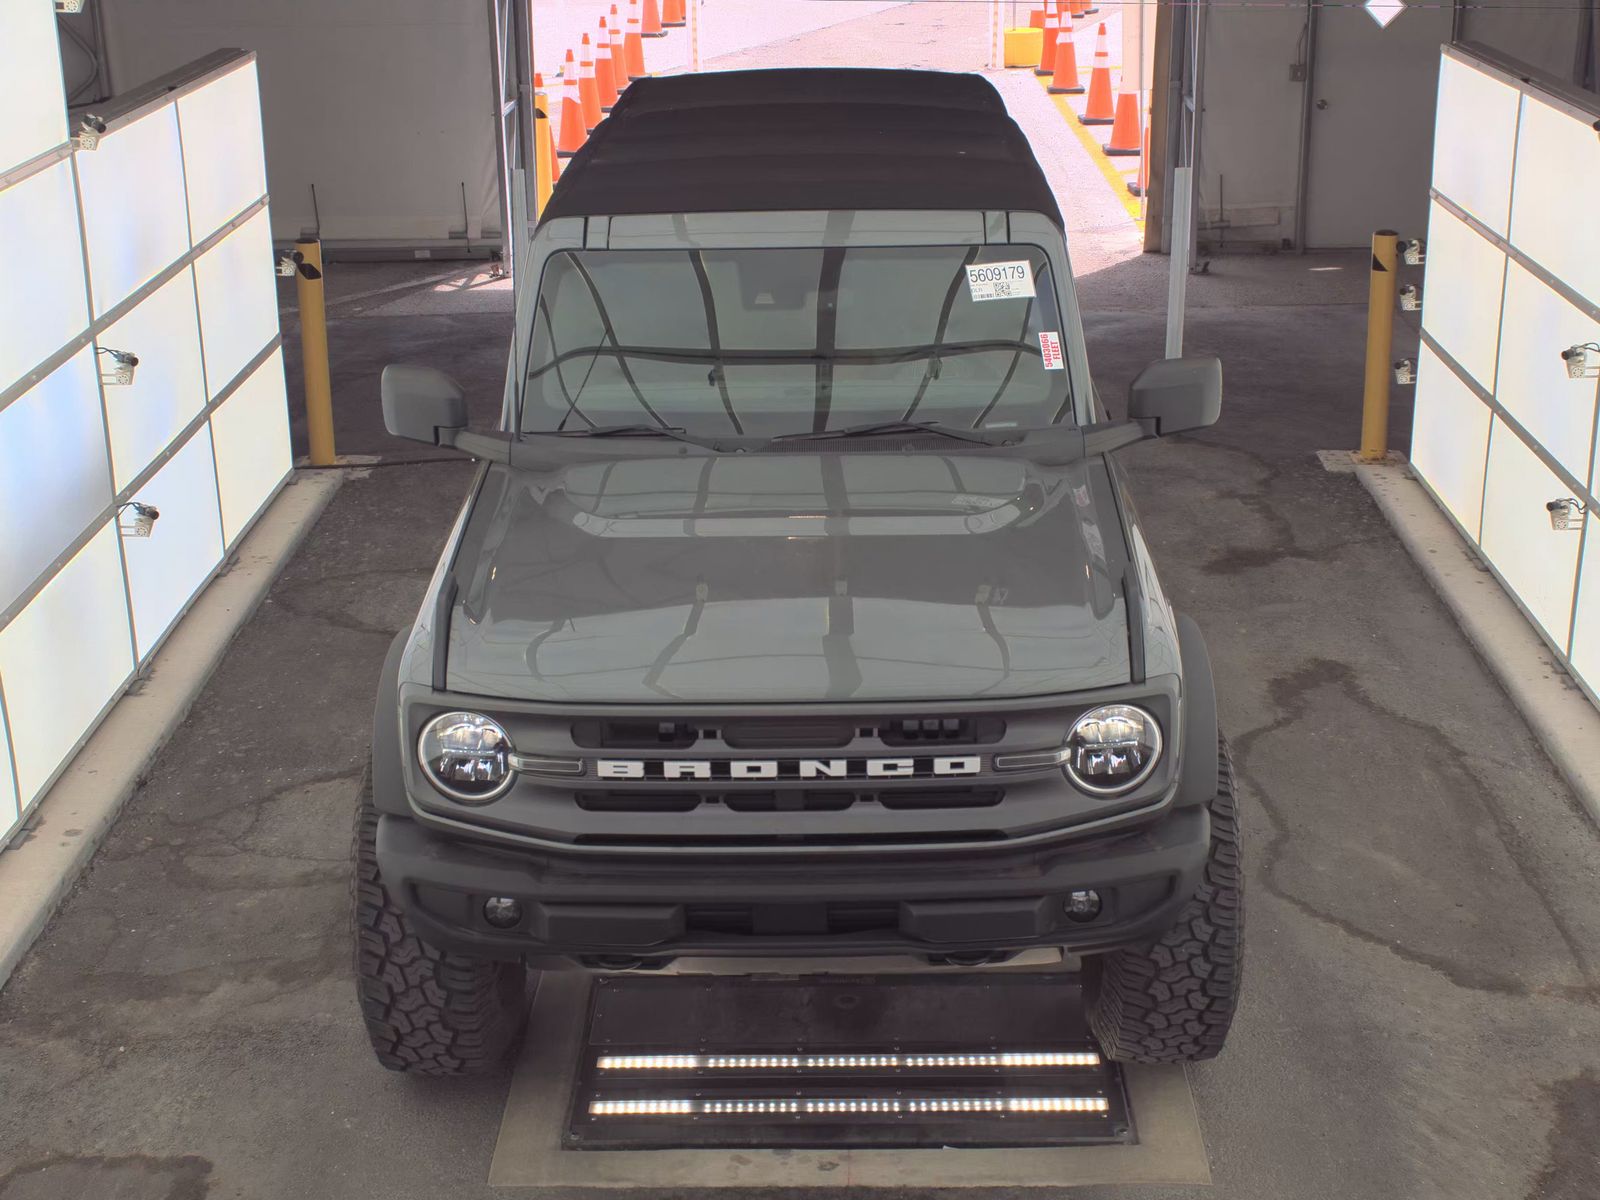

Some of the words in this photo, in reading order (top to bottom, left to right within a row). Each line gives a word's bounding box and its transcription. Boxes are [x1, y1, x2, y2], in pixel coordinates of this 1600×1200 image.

[969, 265, 1025, 283] 5609179
[1040, 334, 1053, 368] 5403066
[1050, 341, 1061, 360] FLEET
[597, 756, 981, 779] BRONCO
